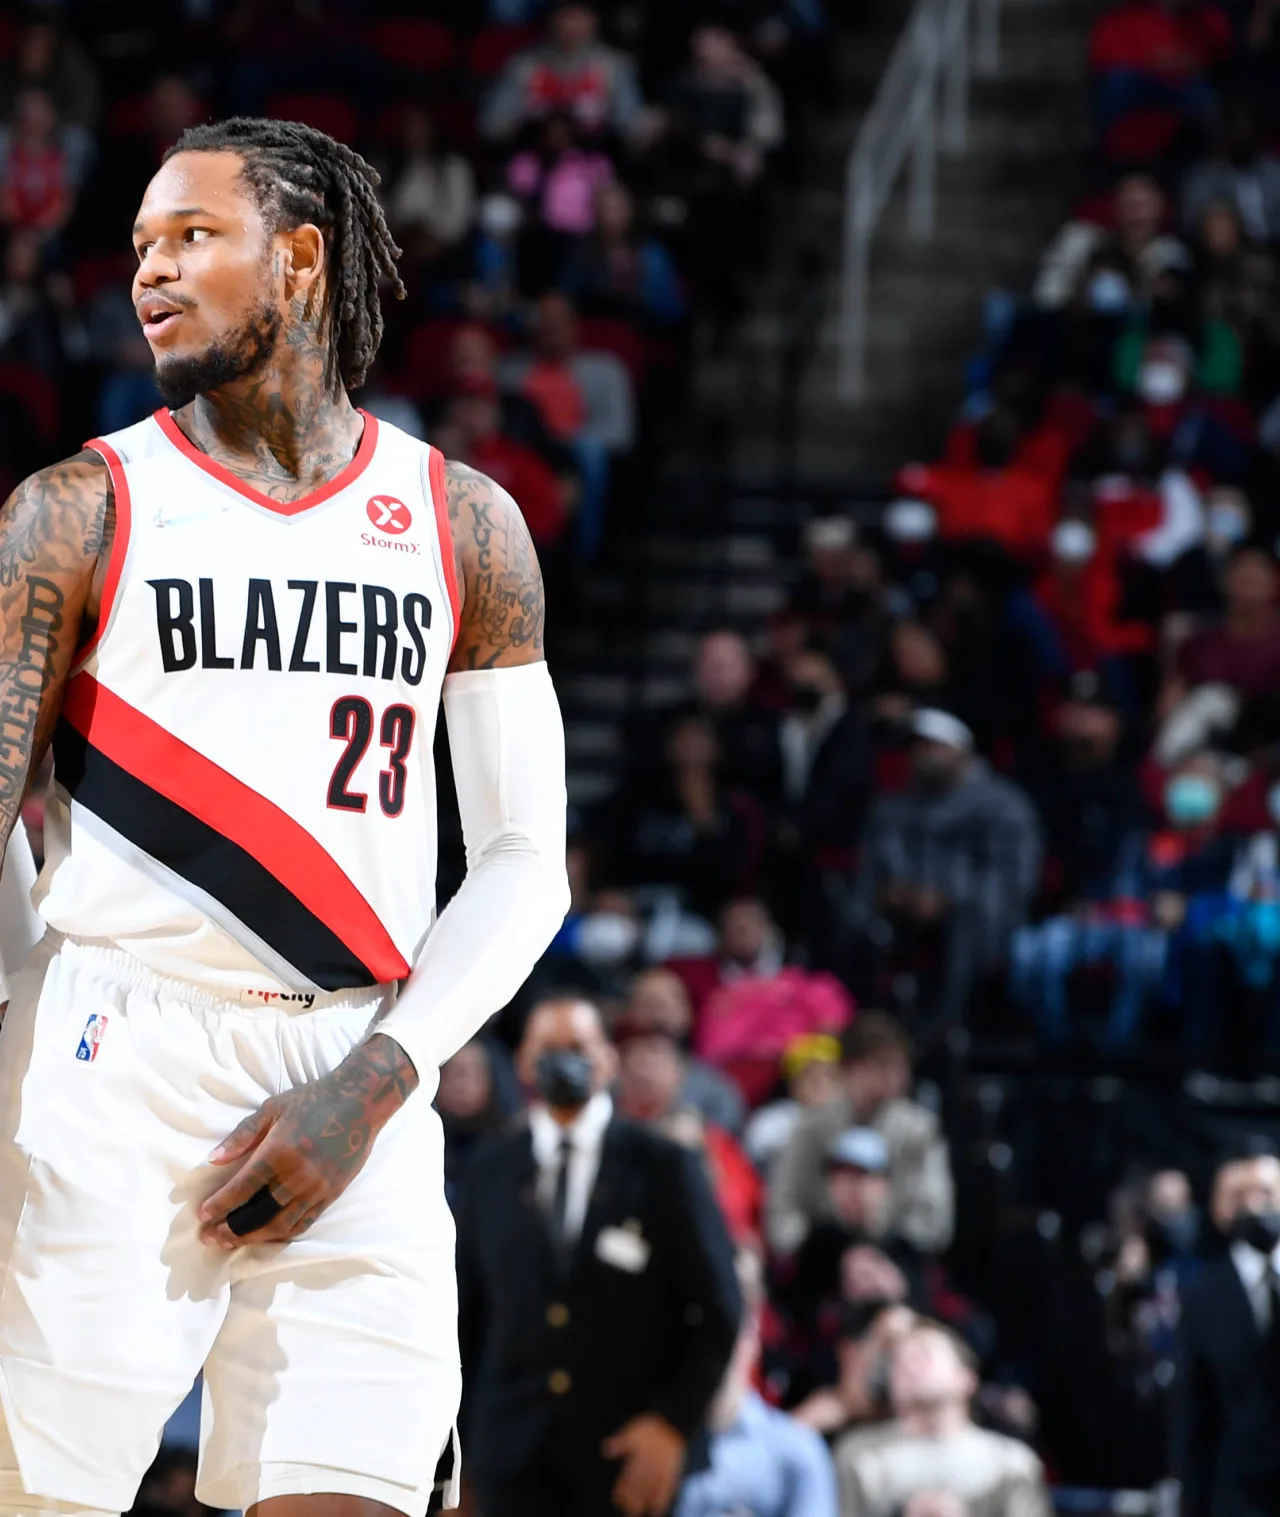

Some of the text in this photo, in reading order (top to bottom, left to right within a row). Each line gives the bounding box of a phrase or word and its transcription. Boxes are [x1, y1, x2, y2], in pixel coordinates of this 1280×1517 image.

[360, 533, 421, 555] StormX
[144, 577, 432, 686] BLAZERS
[326, 694, 417, 818] 23
